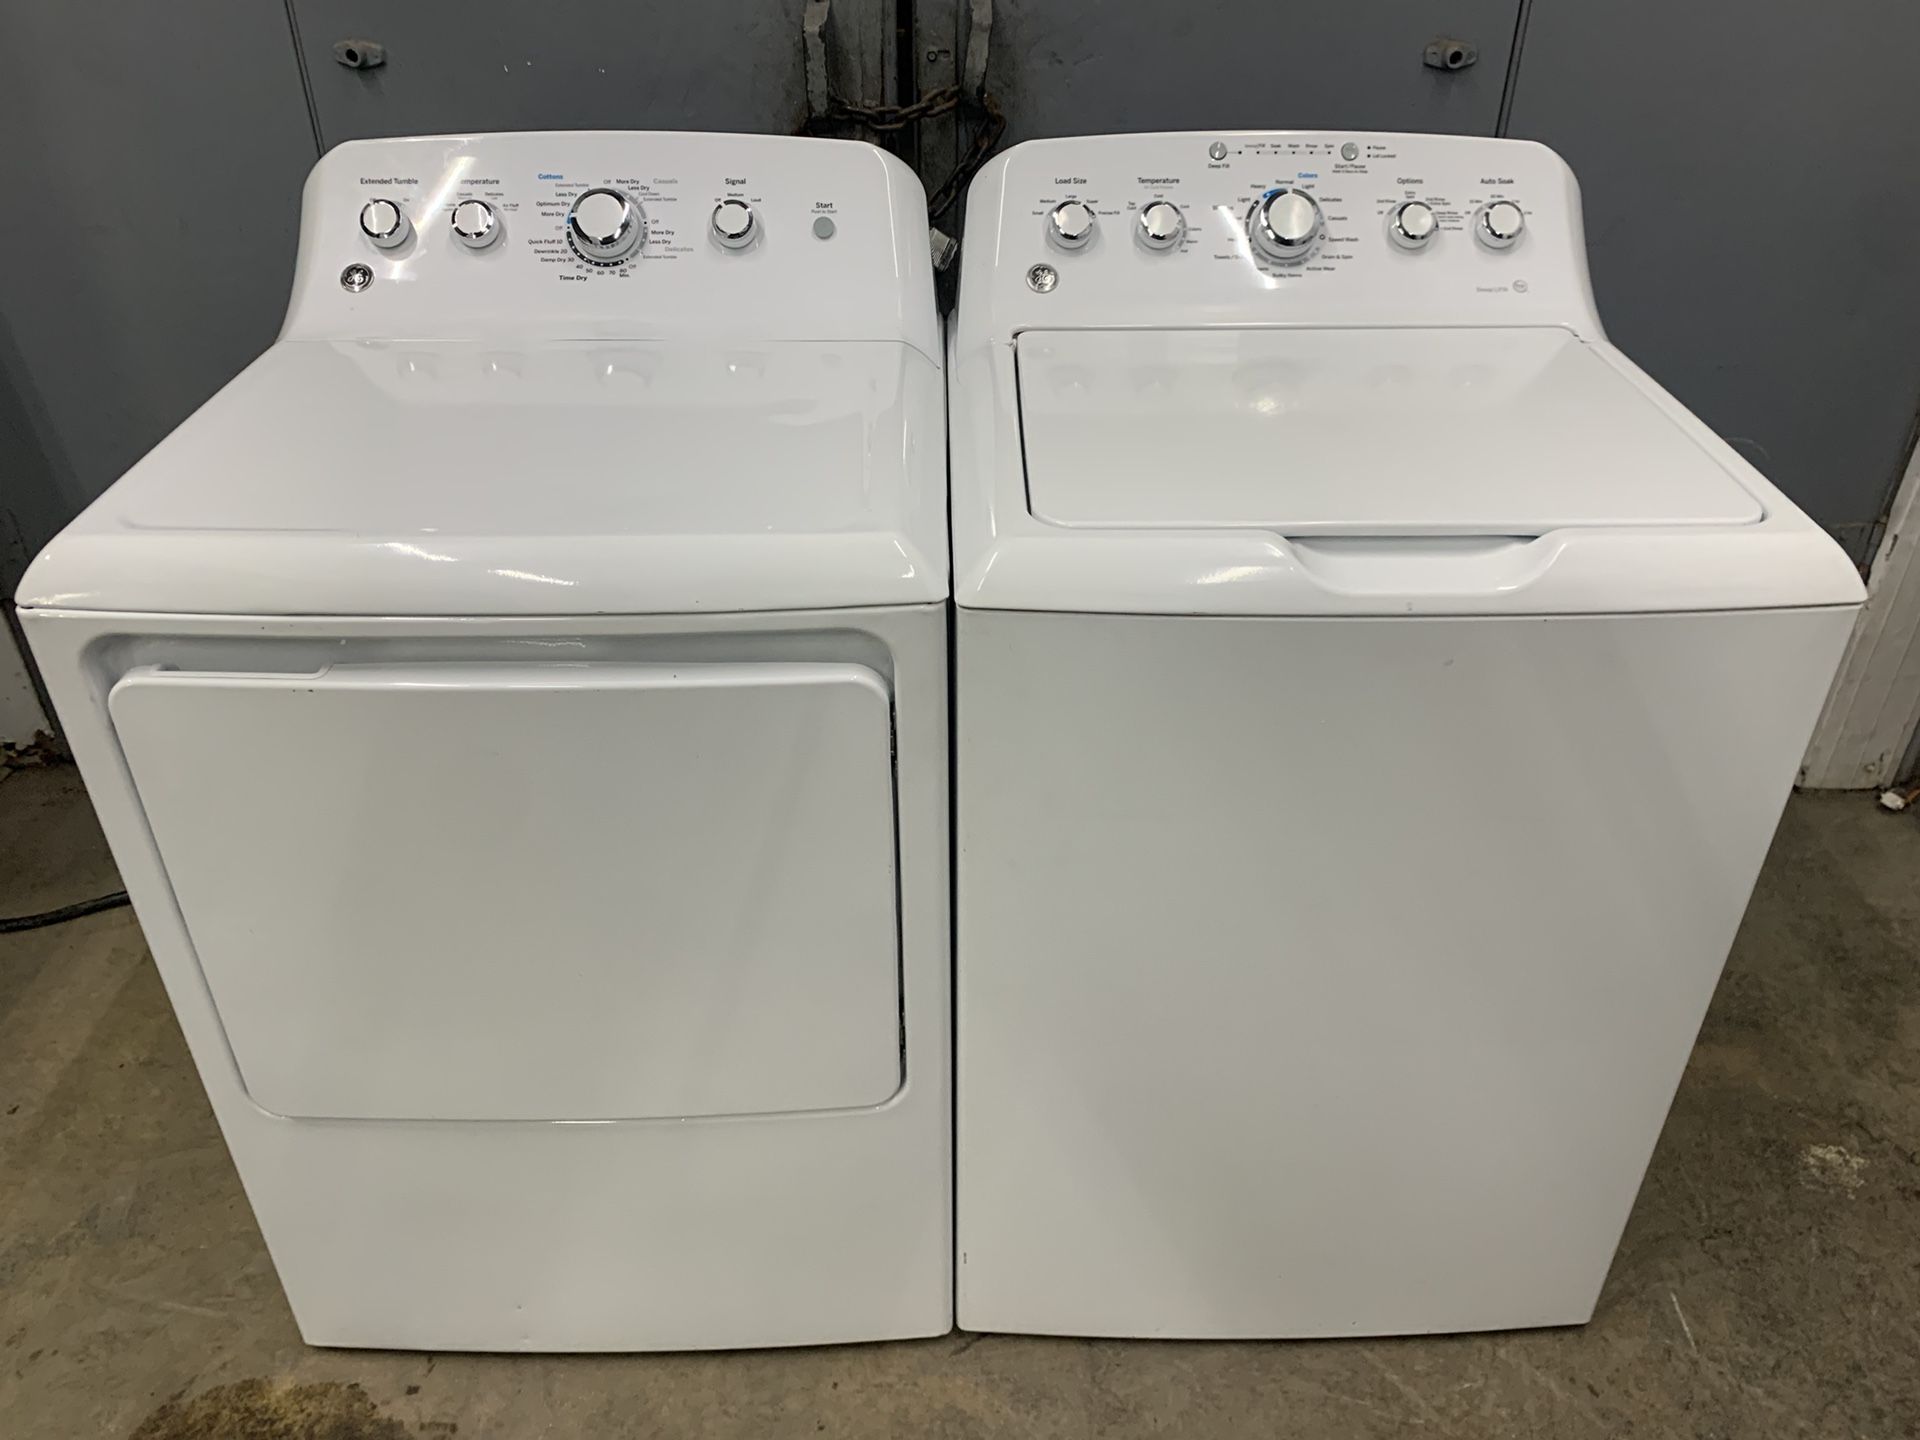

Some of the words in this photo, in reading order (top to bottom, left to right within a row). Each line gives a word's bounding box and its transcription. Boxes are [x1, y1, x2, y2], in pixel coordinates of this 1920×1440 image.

[724, 178, 746, 186] Signal
[1138, 177, 1180, 185] Temperature
[1396, 178, 1424, 186] Options
